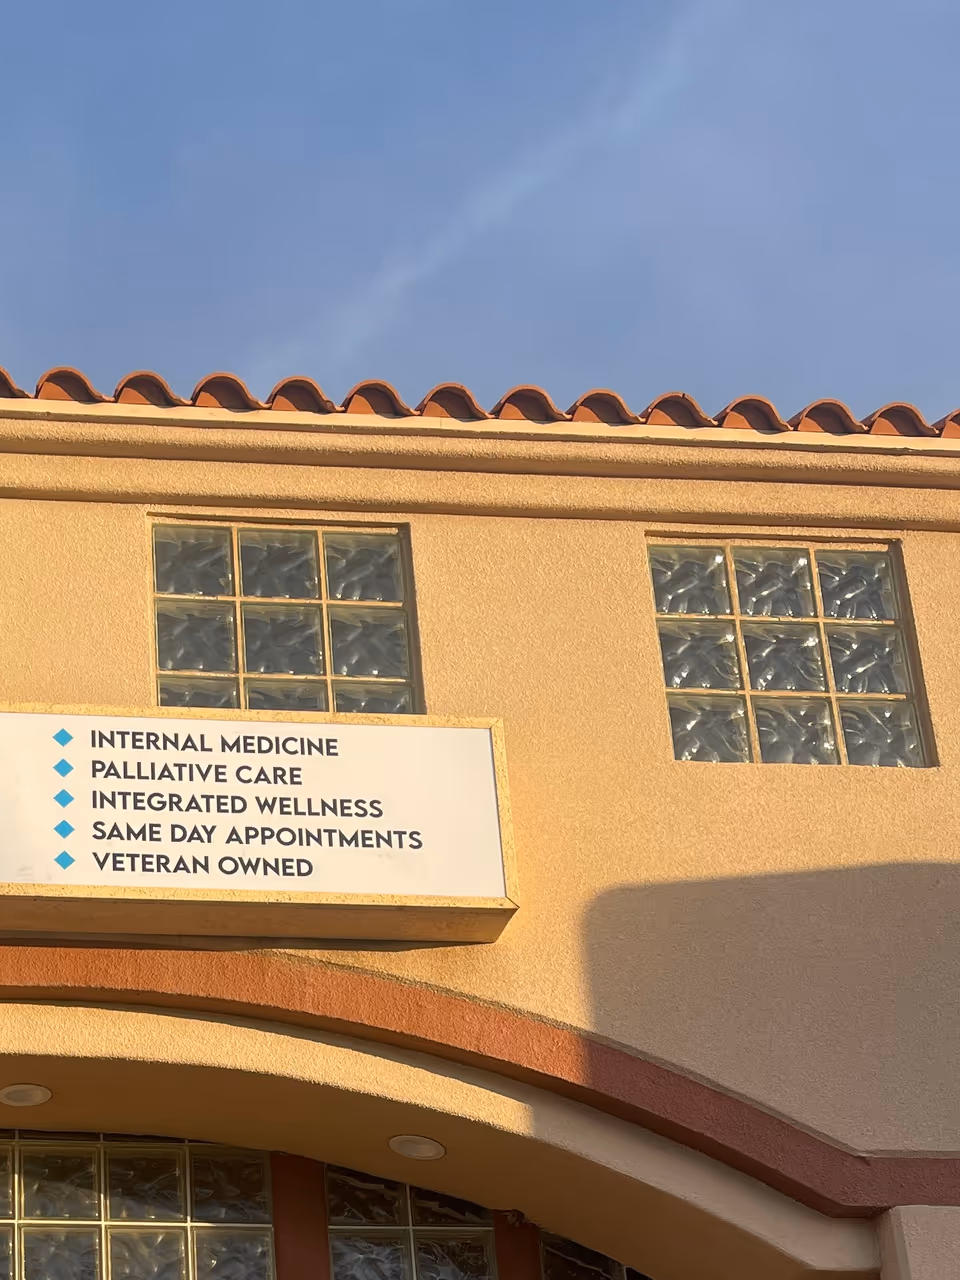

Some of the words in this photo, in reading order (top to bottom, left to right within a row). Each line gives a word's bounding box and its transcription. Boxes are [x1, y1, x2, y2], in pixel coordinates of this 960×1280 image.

[91, 730, 213, 752] INTERNAL
[220, 734, 339, 756] MEDICINE
[91, 760, 227, 783] PALLIATIVE
[235, 765, 303, 785] CARE
[92, 790, 247, 814] INTEGRATED
[255, 796, 383, 818] WELLNESS
[92, 821, 162, 842] SAME
[171, 824, 217, 843] DAY
[225, 826, 423, 850] APPOINTMENTS
[92, 852, 209, 874] VETERAN
[218, 856, 313, 877] OWNED
